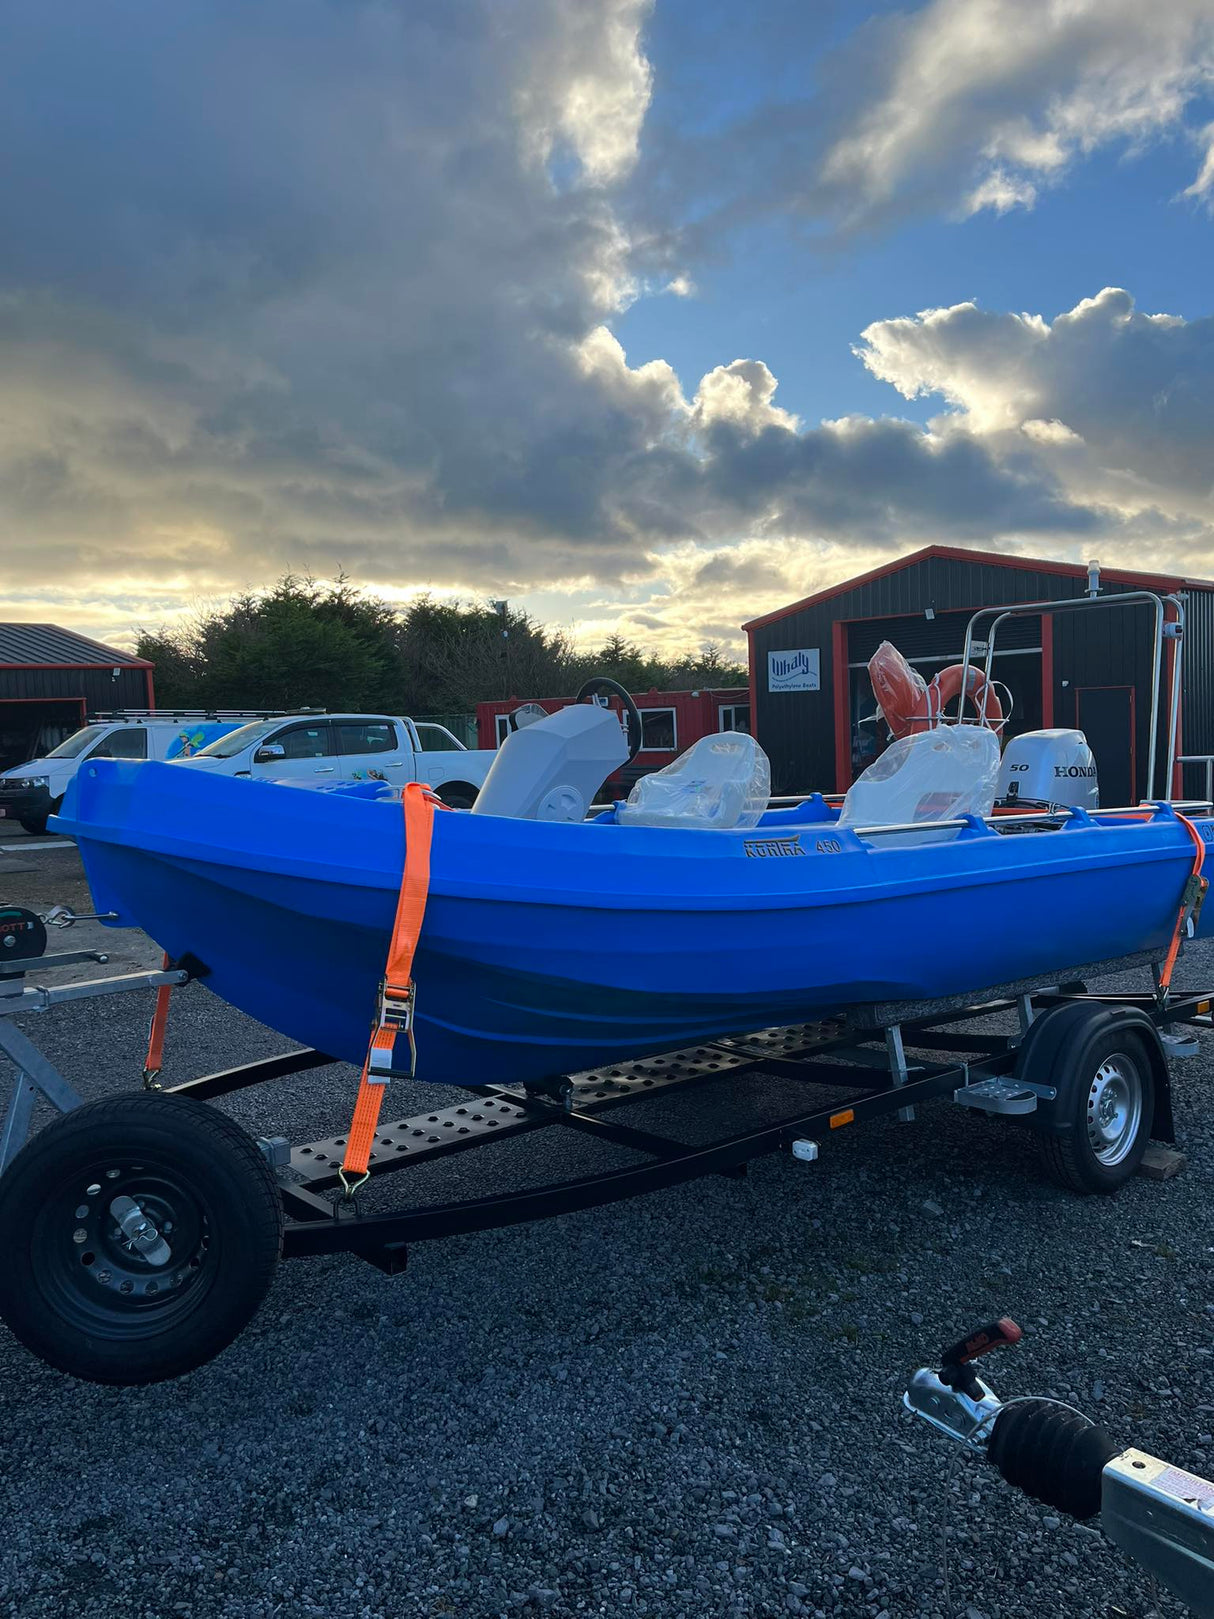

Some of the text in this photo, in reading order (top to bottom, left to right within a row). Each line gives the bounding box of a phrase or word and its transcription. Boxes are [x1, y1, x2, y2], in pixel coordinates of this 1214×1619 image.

[772, 652, 809, 676] Whaly
[1010, 764, 1029, 772] 50
[816, 839, 841, 854] 450
